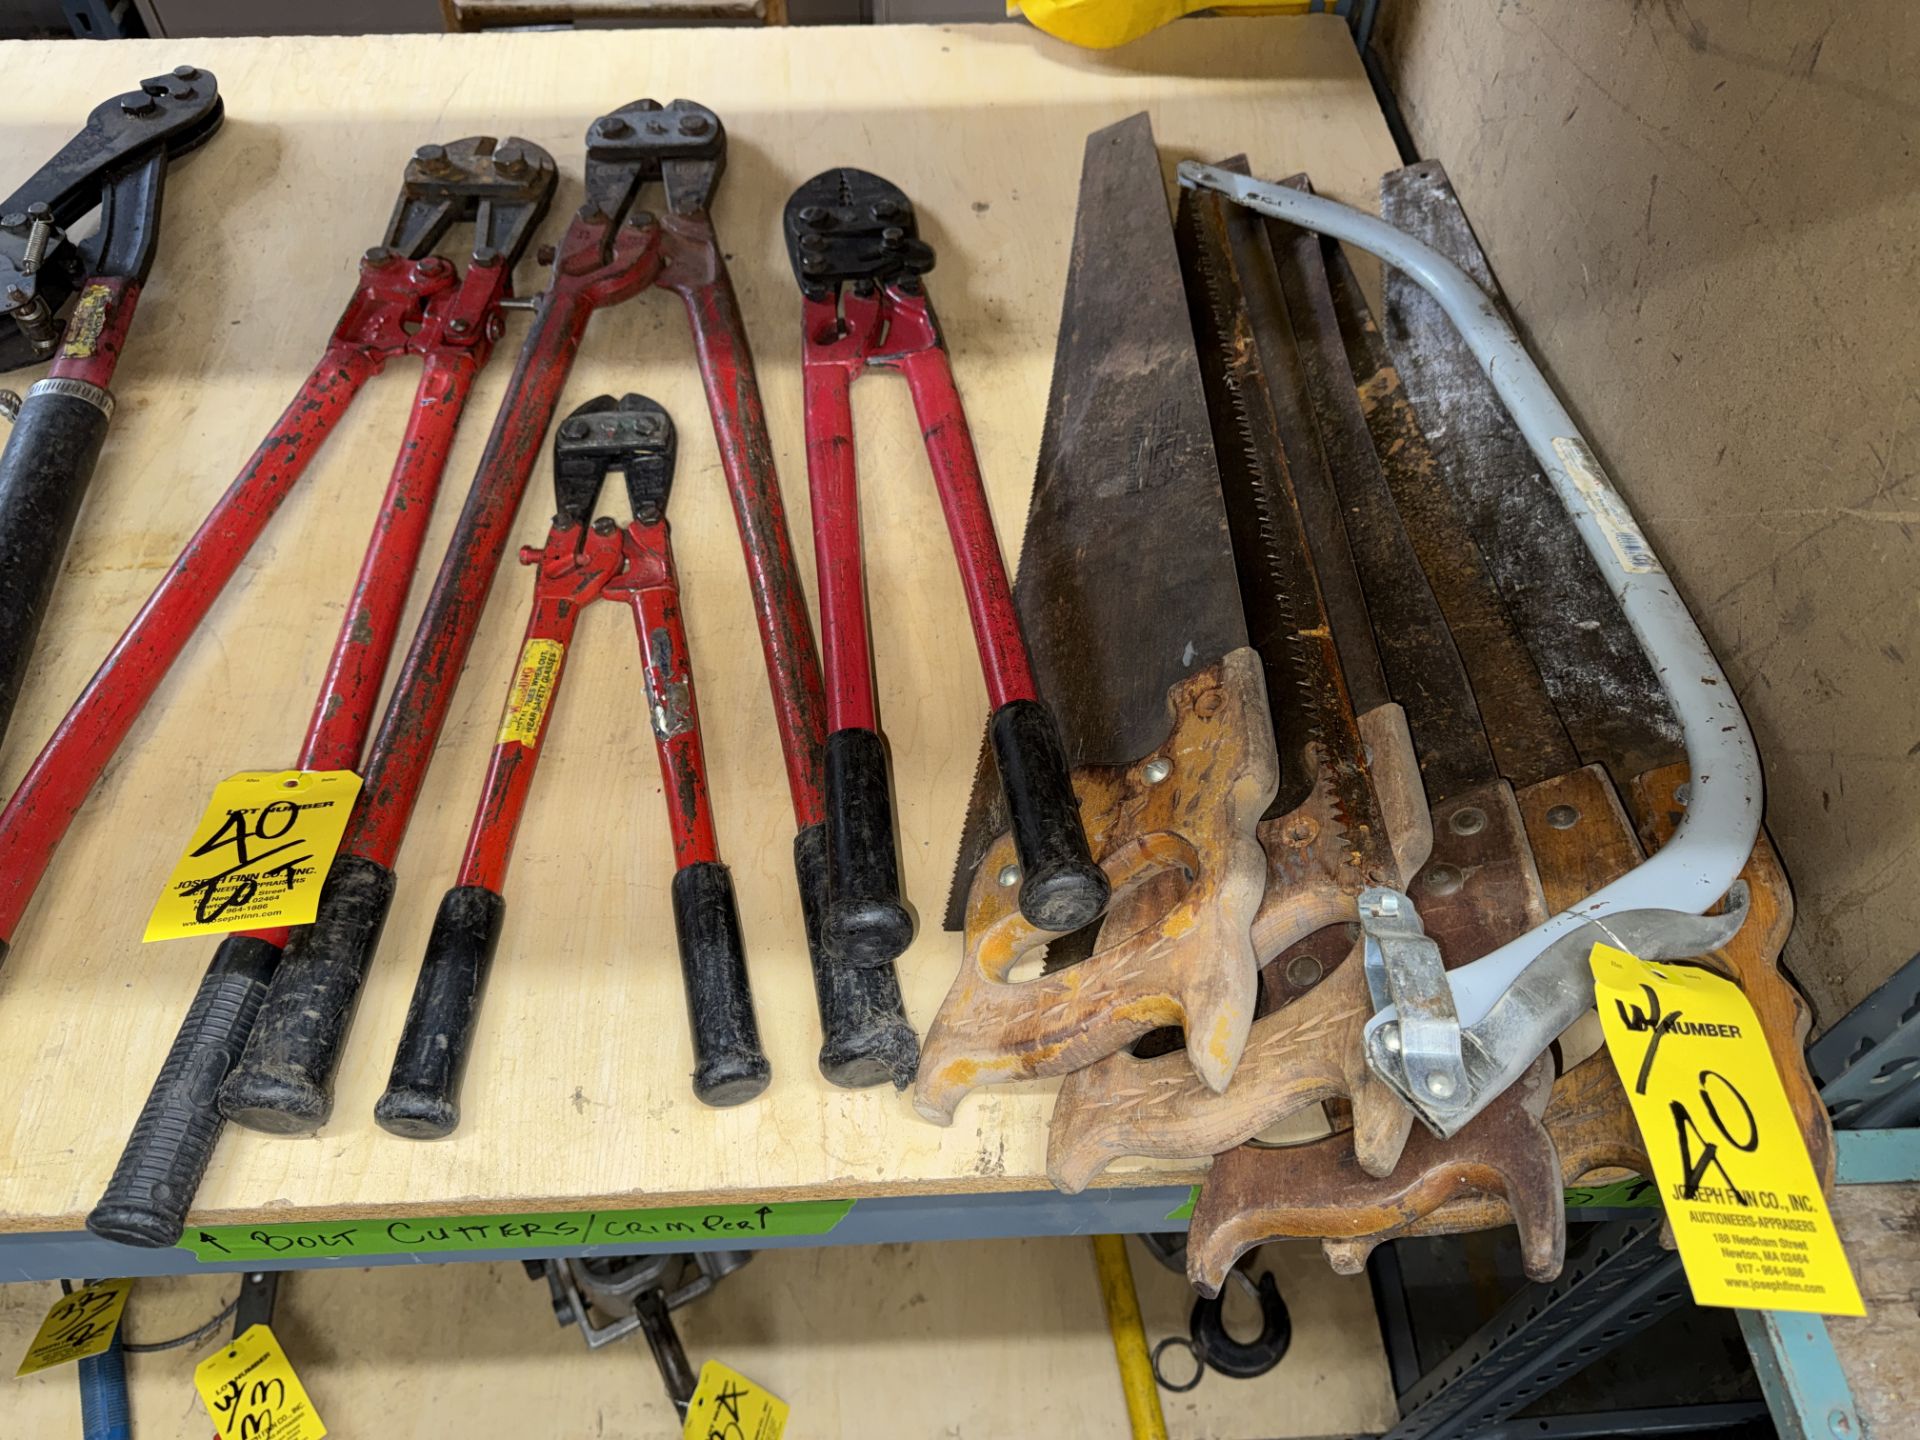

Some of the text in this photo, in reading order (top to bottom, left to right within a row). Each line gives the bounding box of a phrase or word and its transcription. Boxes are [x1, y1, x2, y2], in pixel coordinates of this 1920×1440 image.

[1788, 1193, 1818, 1213] INC.
[1689, 1210, 1817, 1232] AUCTIONEERS-APPRAISERS
[250, 1228, 358, 1252] BOLT
[1733, 1235, 1778, 1248] Needham
[1779, 1238, 1808, 1250] Street
